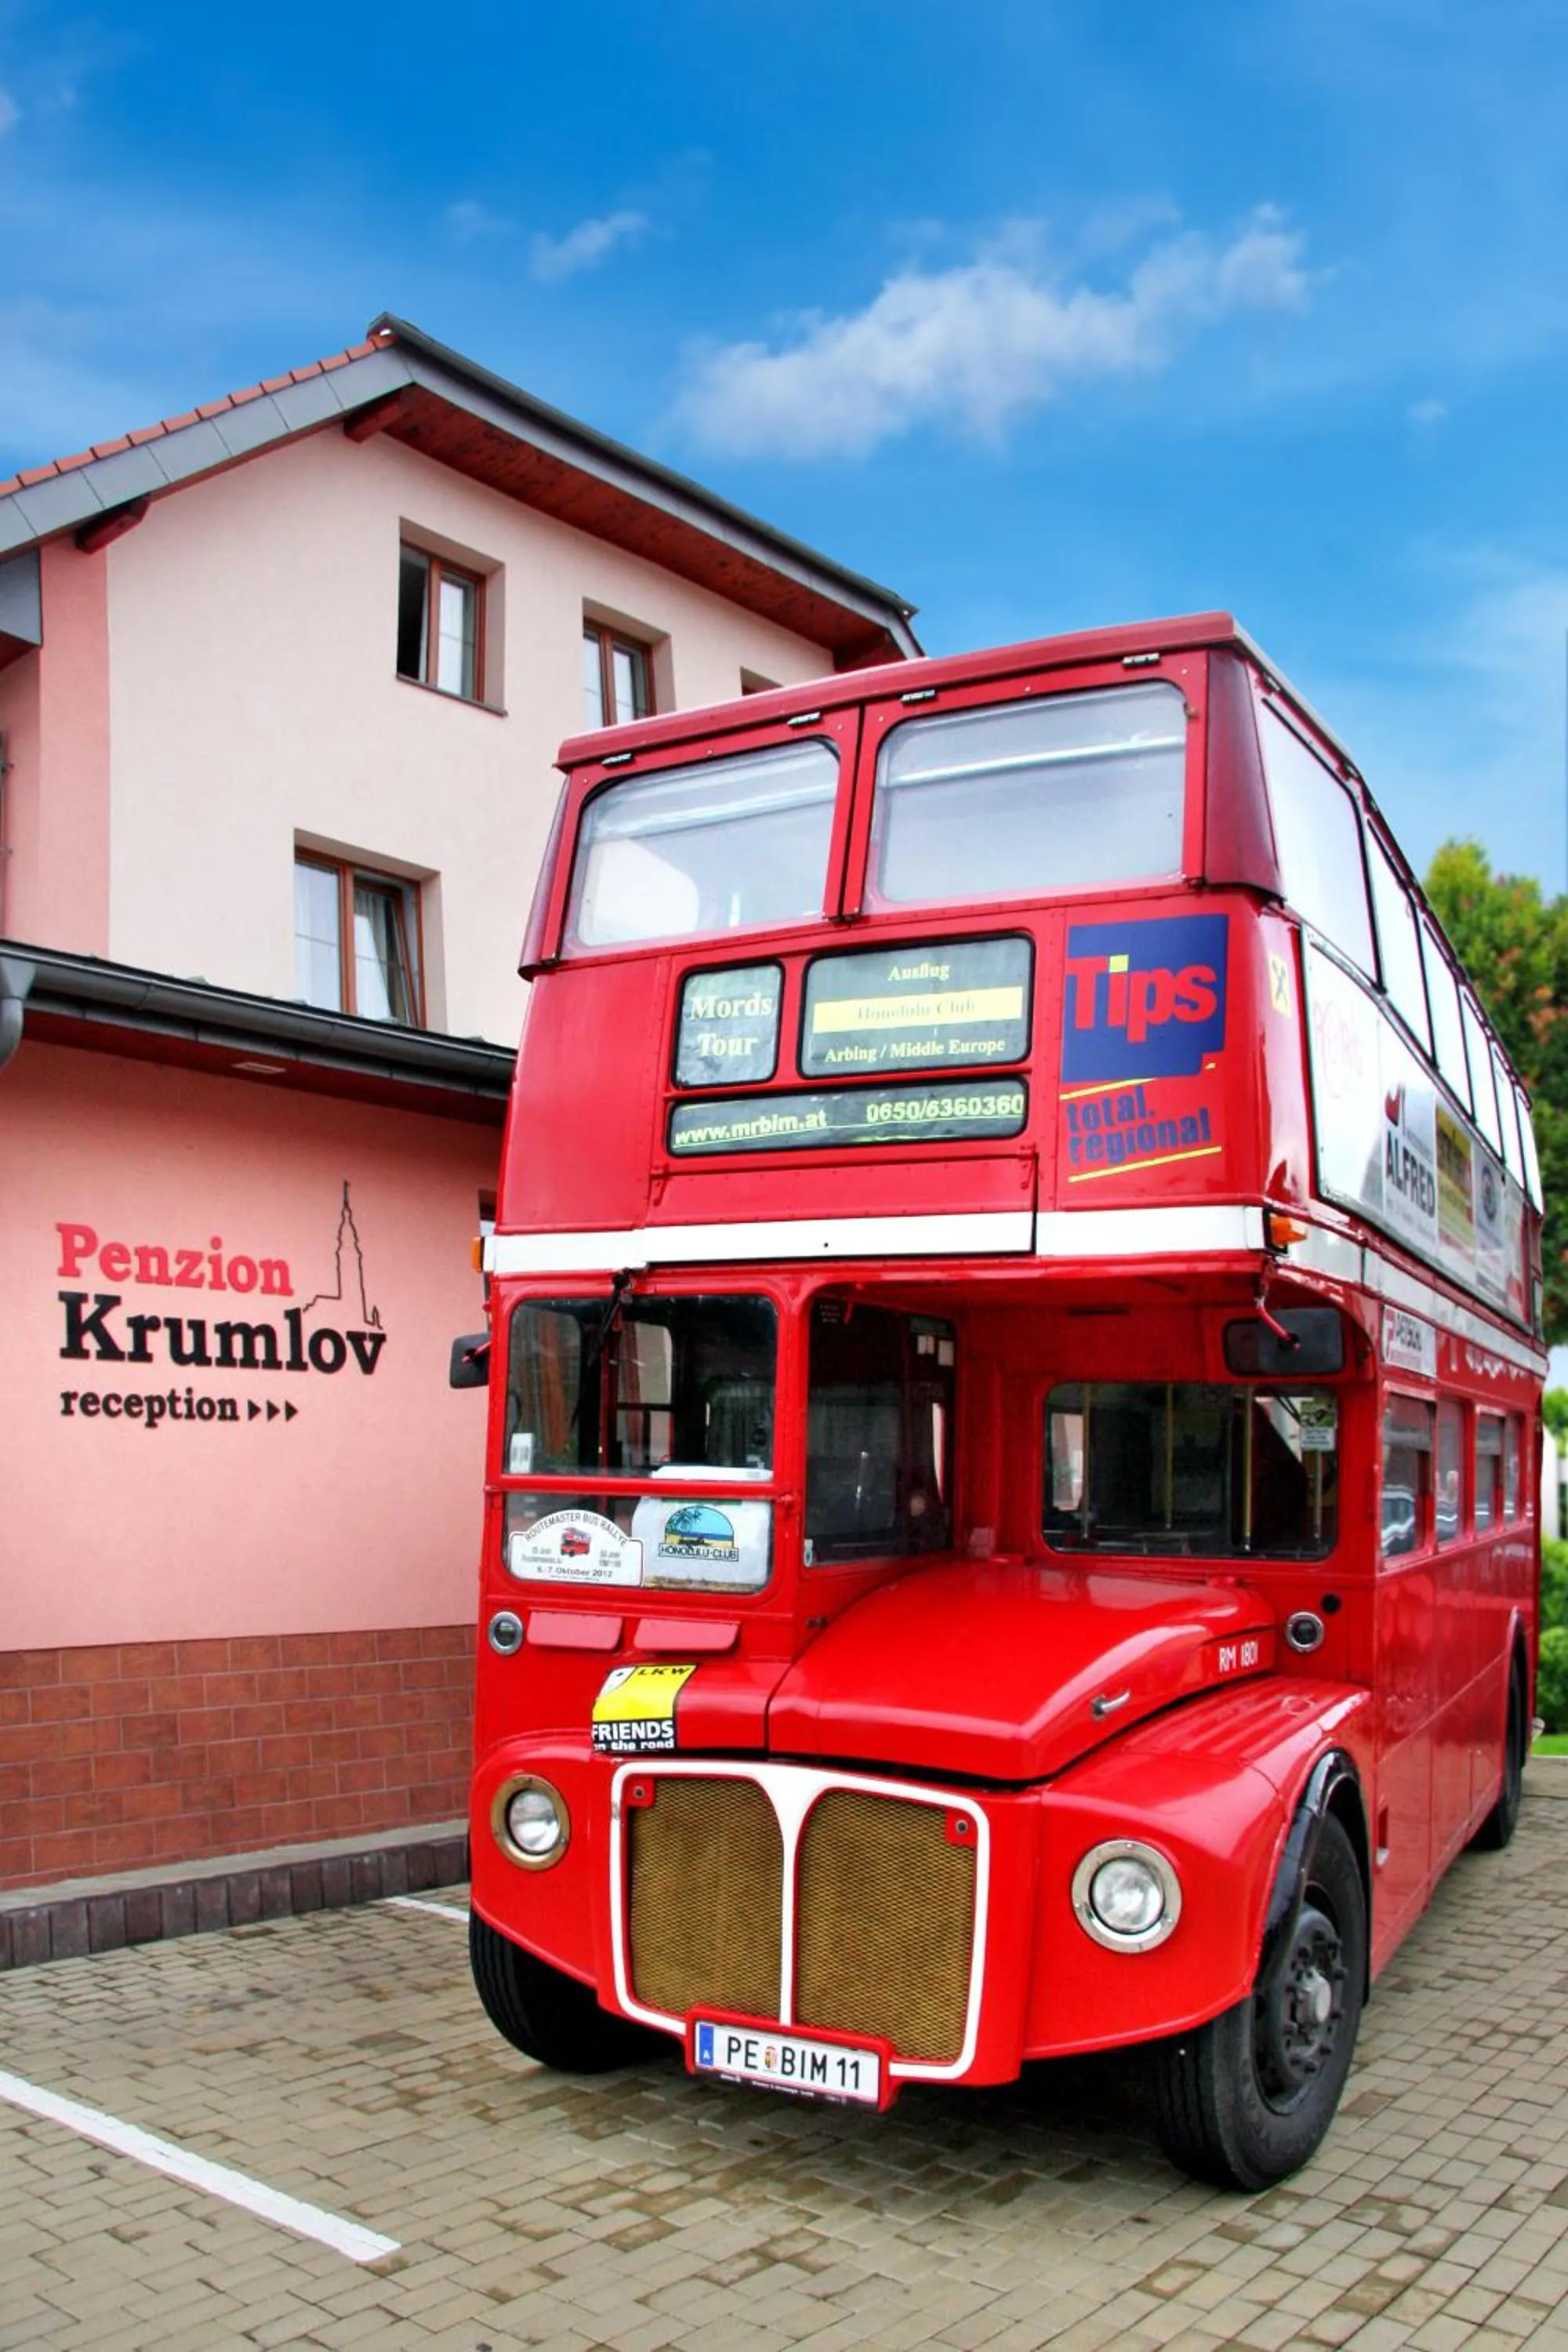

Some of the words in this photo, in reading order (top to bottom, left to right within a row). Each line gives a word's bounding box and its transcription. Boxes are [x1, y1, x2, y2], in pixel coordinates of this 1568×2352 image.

[887, 963, 951, 982] Ausflug
[690, 993, 774, 1020] Mords
[936, 998, 976, 1016] Club
[1065, 953, 1218, 1043] Tips
[698, 1033, 758, 1057] Tour
[826, 1047, 877, 1063] Arbing
[890, 1042, 944, 1058] Middle
[949, 1038, 1006, 1056] Europe
[674, 1109, 827, 1145] www.mrbim.at
[866, 1094, 1025, 1123] 0650/6360360
[1066, 1083, 1156, 1134] total.
[1069, 1107, 1212, 1165] regional
[1385, 1130, 1436, 1218] ALFRED
[56, 1222, 294, 1297] Penzion
[58, 1290, 387, 1375] Krumlov
[60, 1386, 239, 1428] reception
[525, 1512, 581, 1541] ROUTEMASTER
[1219, 1646, 1236, 1673] RM
[611, 1740, 636, 1751] the
[641, 1737, 674, 1749] road
[727, 2035, 760, 2070] PE
